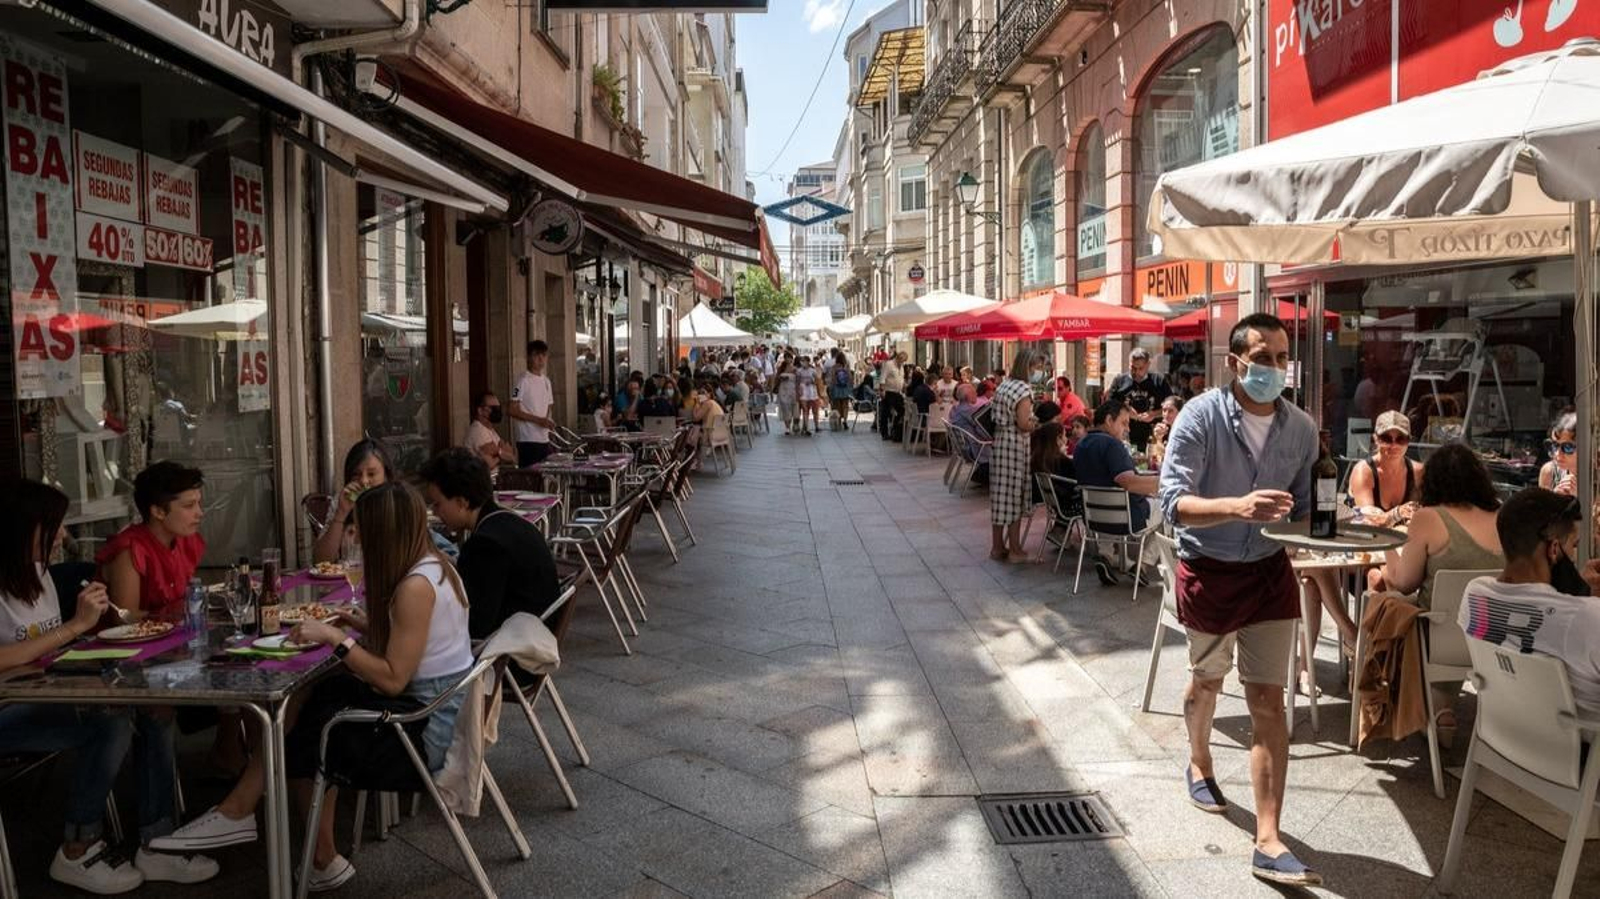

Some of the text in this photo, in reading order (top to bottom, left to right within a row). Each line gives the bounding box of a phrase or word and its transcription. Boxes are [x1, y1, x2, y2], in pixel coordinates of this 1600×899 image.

[5, 60, 65, 124] RE
[8, 124, 69, 184] BA
[84, 150, 134, 182] SEGUNDAS
[88, 177, 131, 205] REBAJAS
[152, 171, 192, 198] SEGUNDAS
[234, 175, 263, 214] RE
[156, 195, 191, 219] REBAJAS
[88, 222, 134, 260] 40%
[145, 229, 179, 262] 50%
[183, 237, 214, 269] 60%
[235, 219, 263, 255] BA
[1147, 262, 1189, 298] PENIN
[19, 313, 75, 361] AS
[240, 351, 268, 386] AS
